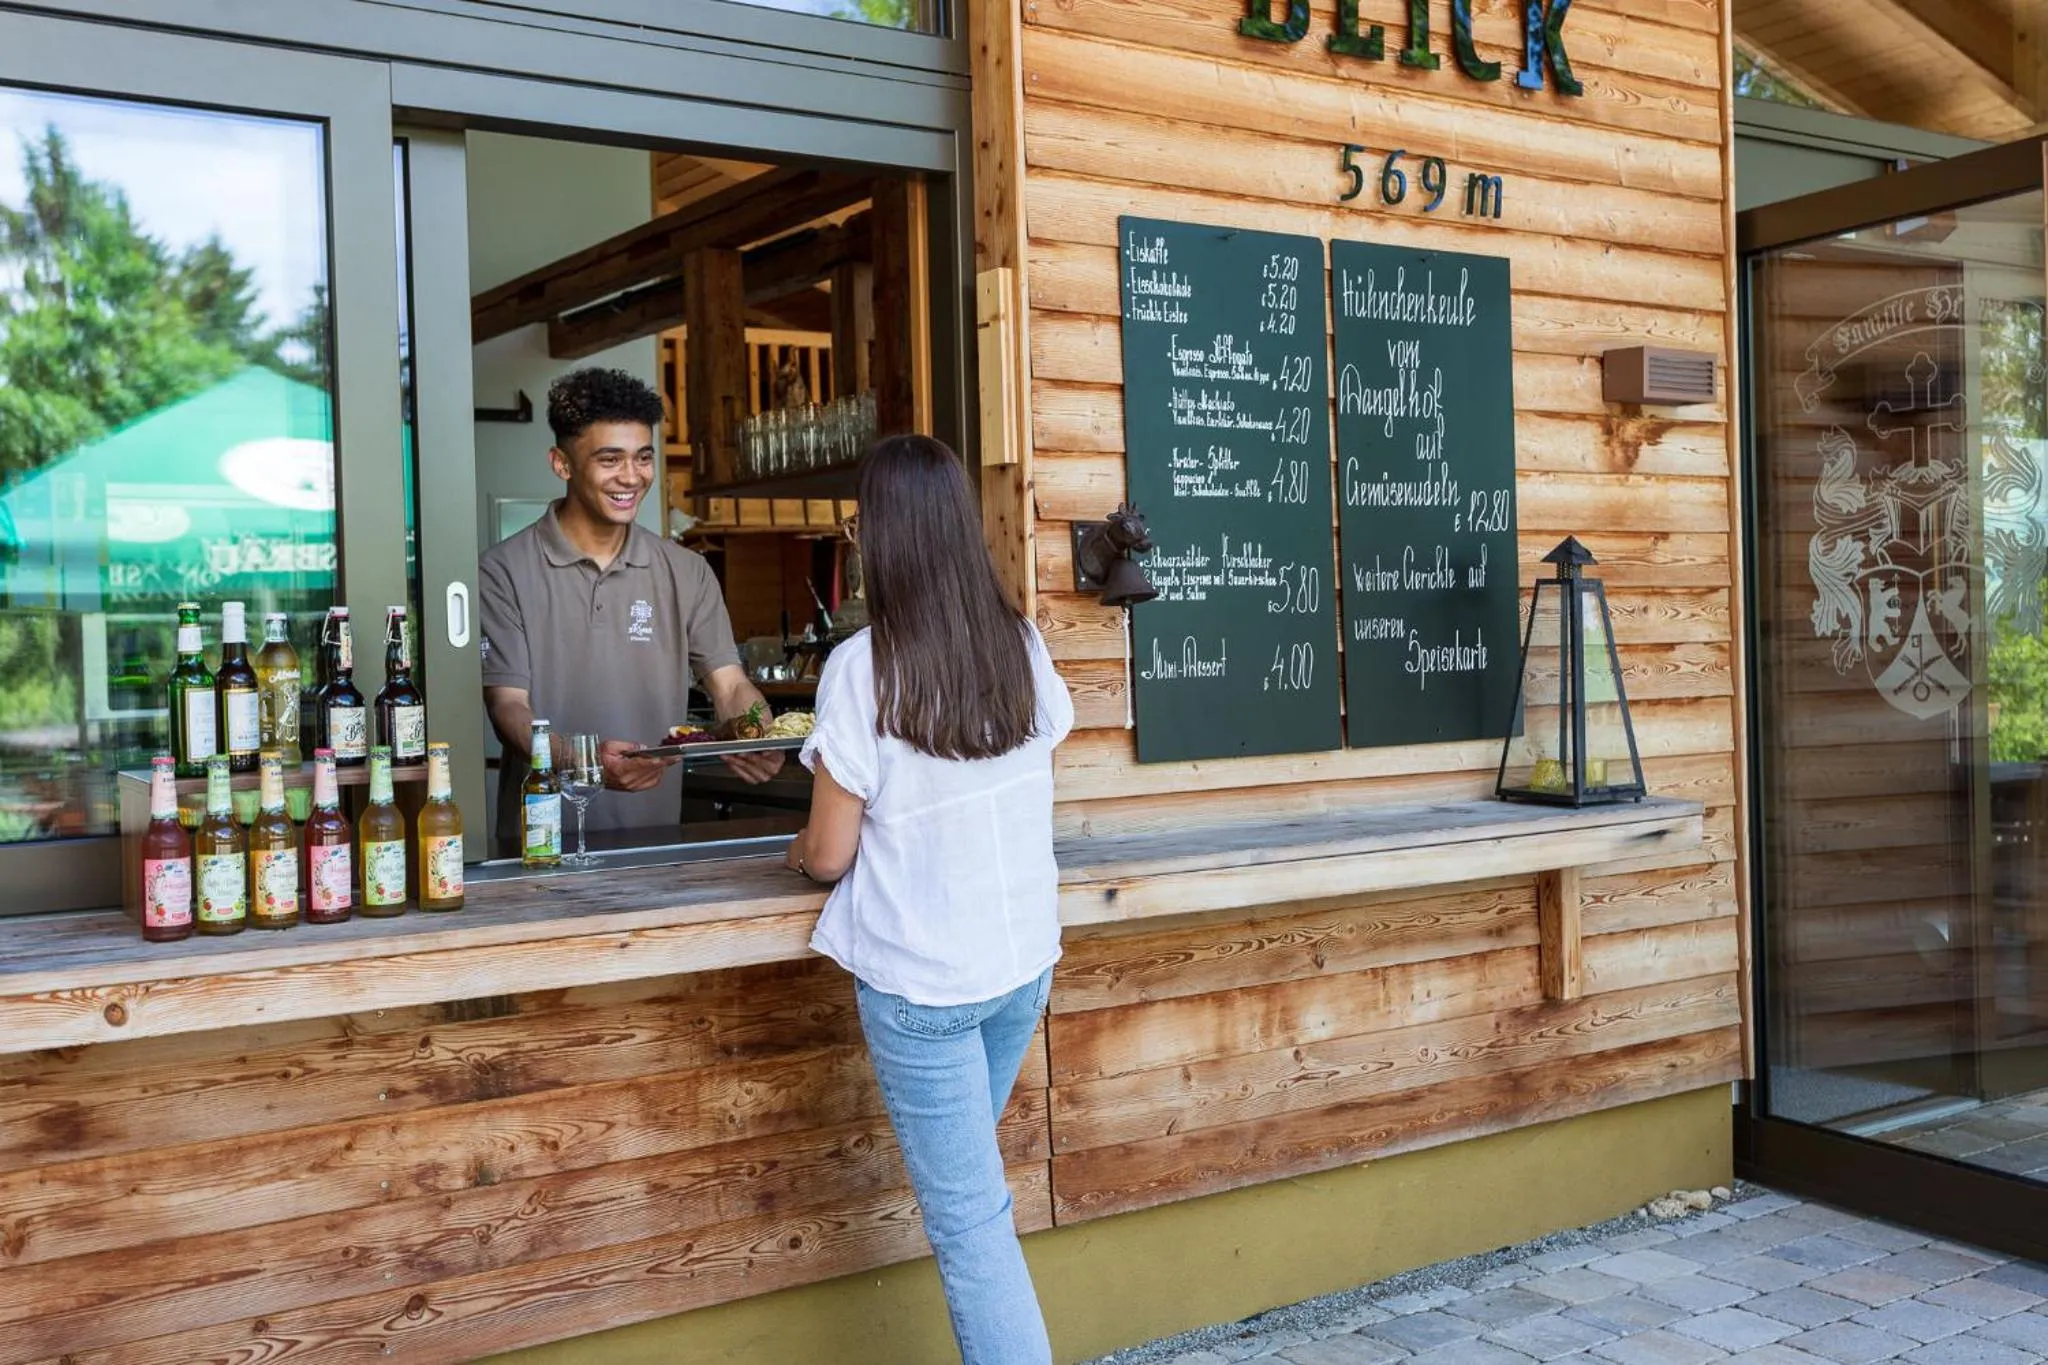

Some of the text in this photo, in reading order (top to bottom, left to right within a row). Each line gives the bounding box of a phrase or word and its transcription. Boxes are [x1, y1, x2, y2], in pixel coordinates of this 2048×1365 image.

[1339, 143, 1503, 219] 569 m
[1342, 266, 1477, 327] Hühnchenkeule
[1388, 339, 1421, 368] vom
[1416, 413, 1446, 460] auf
[1345, 457, 1461, 507] Gemüsenudeln
[1403, 545, 1457, 590] Gerichte
[1468, 543, 1489, 588] auf
[1405, 628, 1488, 691] Speisekarte
